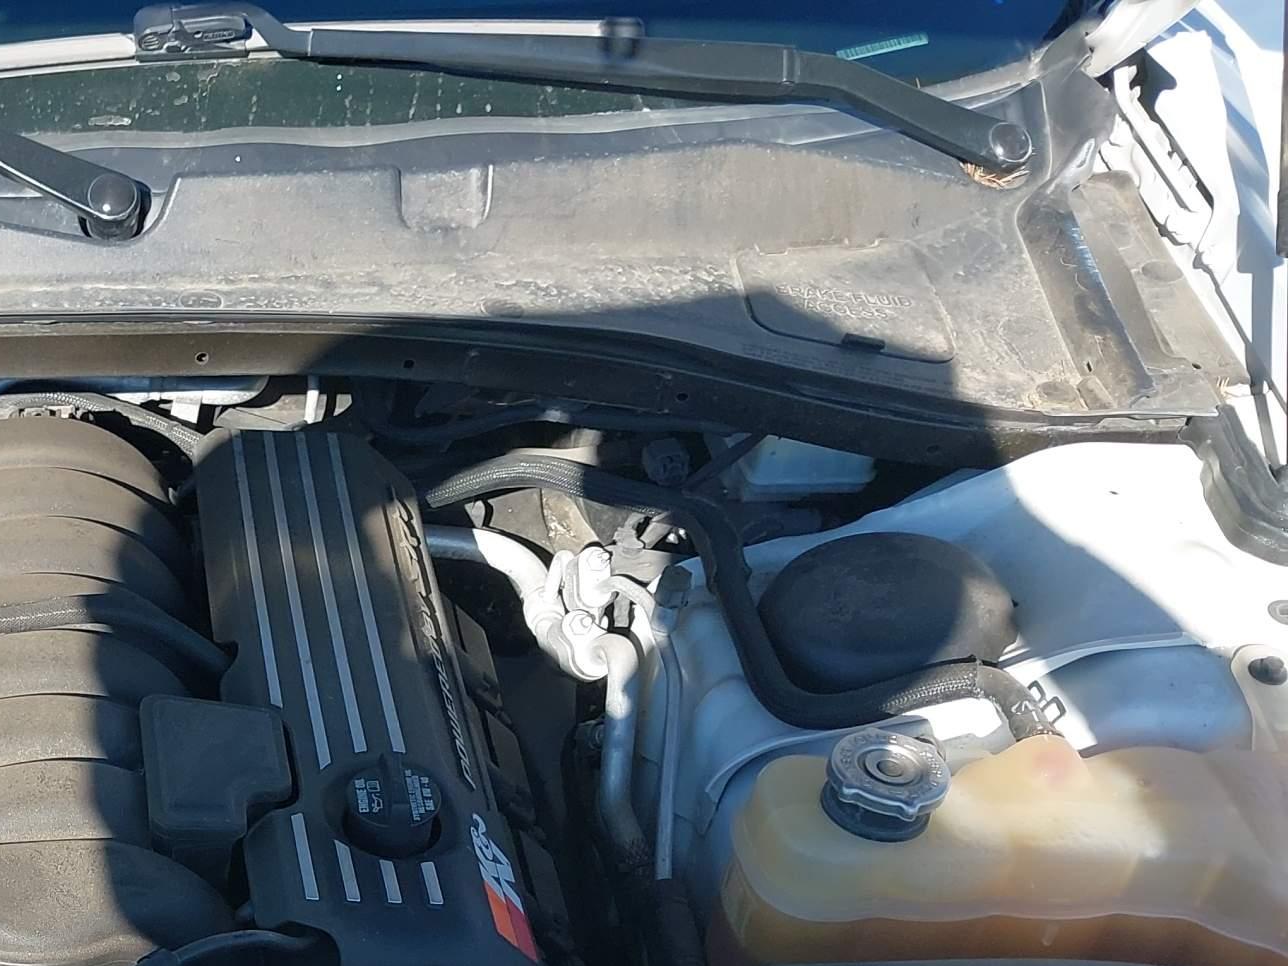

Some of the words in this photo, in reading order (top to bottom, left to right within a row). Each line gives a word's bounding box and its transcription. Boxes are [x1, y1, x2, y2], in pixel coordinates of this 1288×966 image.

[775, 283, 849, 303] BRAKE
[852, 293, 912, 307] FLUID
[803, 299, 888, 319] ACCESS
[429, 636, 477, 790] POWERED
